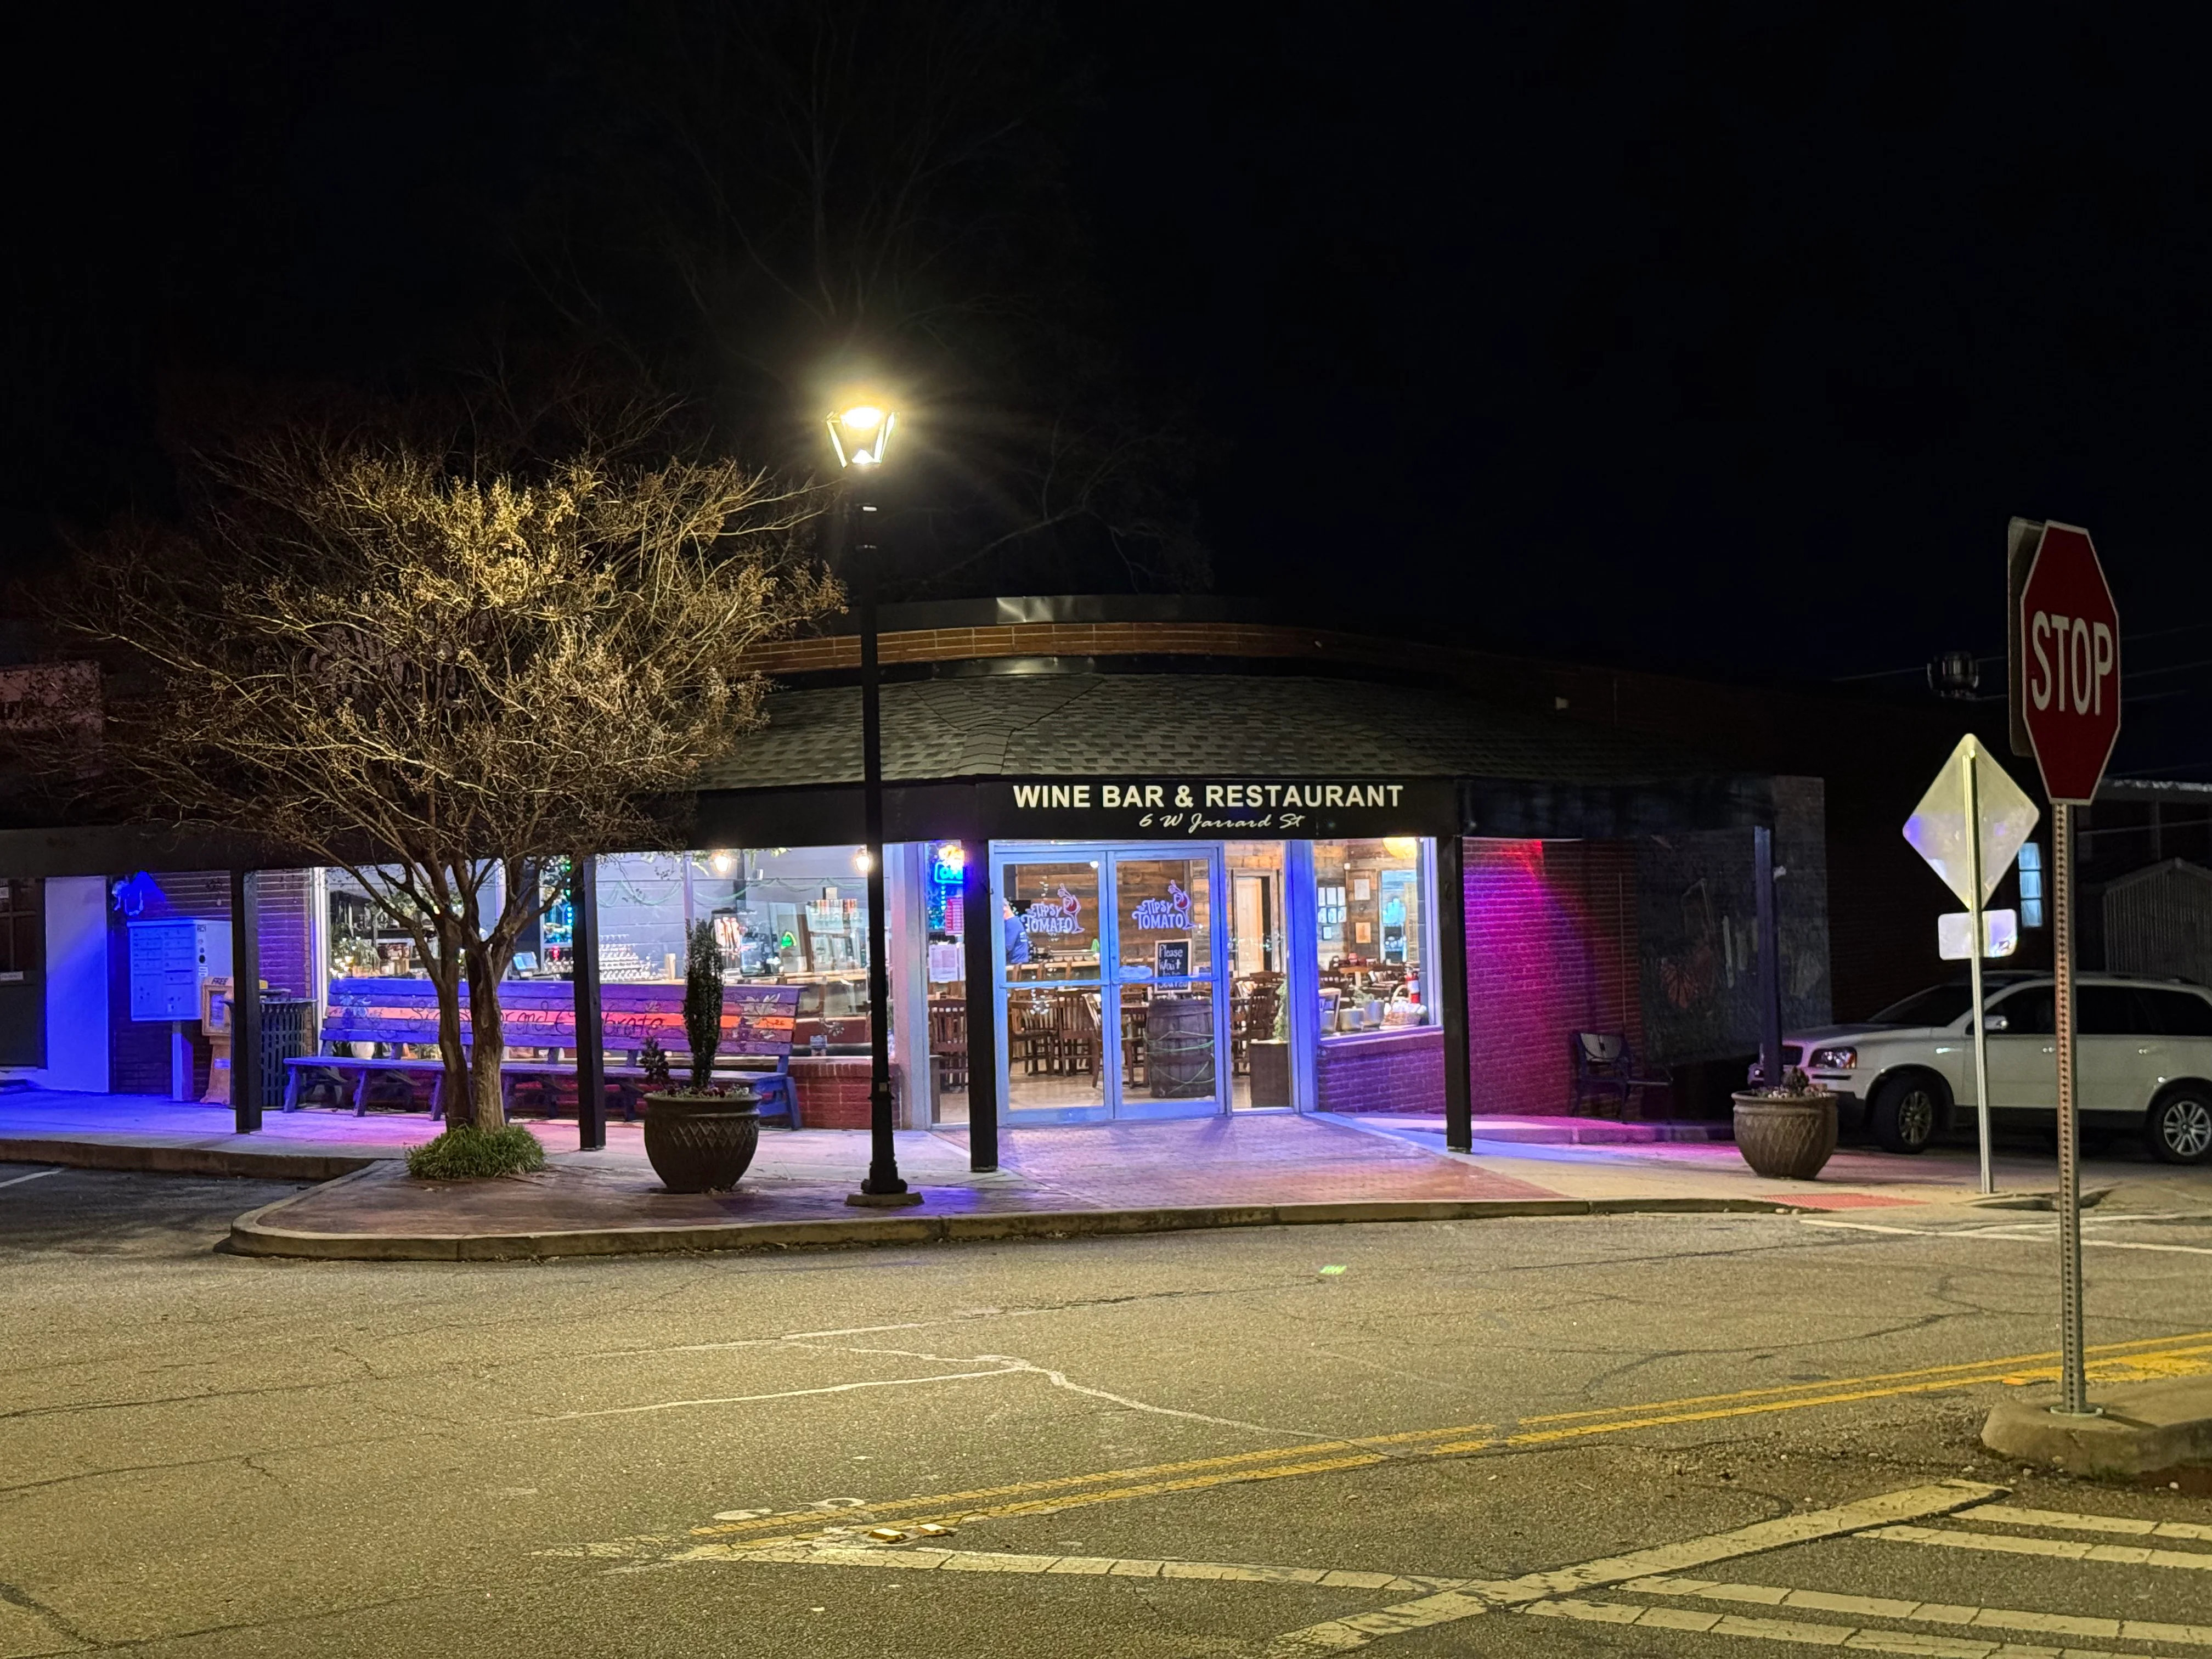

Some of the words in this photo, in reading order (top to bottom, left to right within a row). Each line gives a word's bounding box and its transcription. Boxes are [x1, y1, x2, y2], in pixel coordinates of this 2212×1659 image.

[2032, 610, 2112, 716] STOP
[1013, 785, 1091, 808] WINE
[1102, 785, 1164, 808] BAR
[1175, 785, 1194, 808] &
[1206, 785, 1403, 807] RESTAURANT
[1139, 813, 1153, 827] 6
[1159, 813, 1183, 827] W
[1188, 812, 1272, 834] Jarrard
[1279, 812, 1306, 829] St
[1142, 898, 1173, 915] TIPSY
[1021, 914, 1073, 933] TOMATO
[1132, 911, 1184, 930] TOMATO
[1159, 944, 1183, 958] Please
[1159, 958, 1181, 970] Wait
[211, 977, 229, 985] FREE
